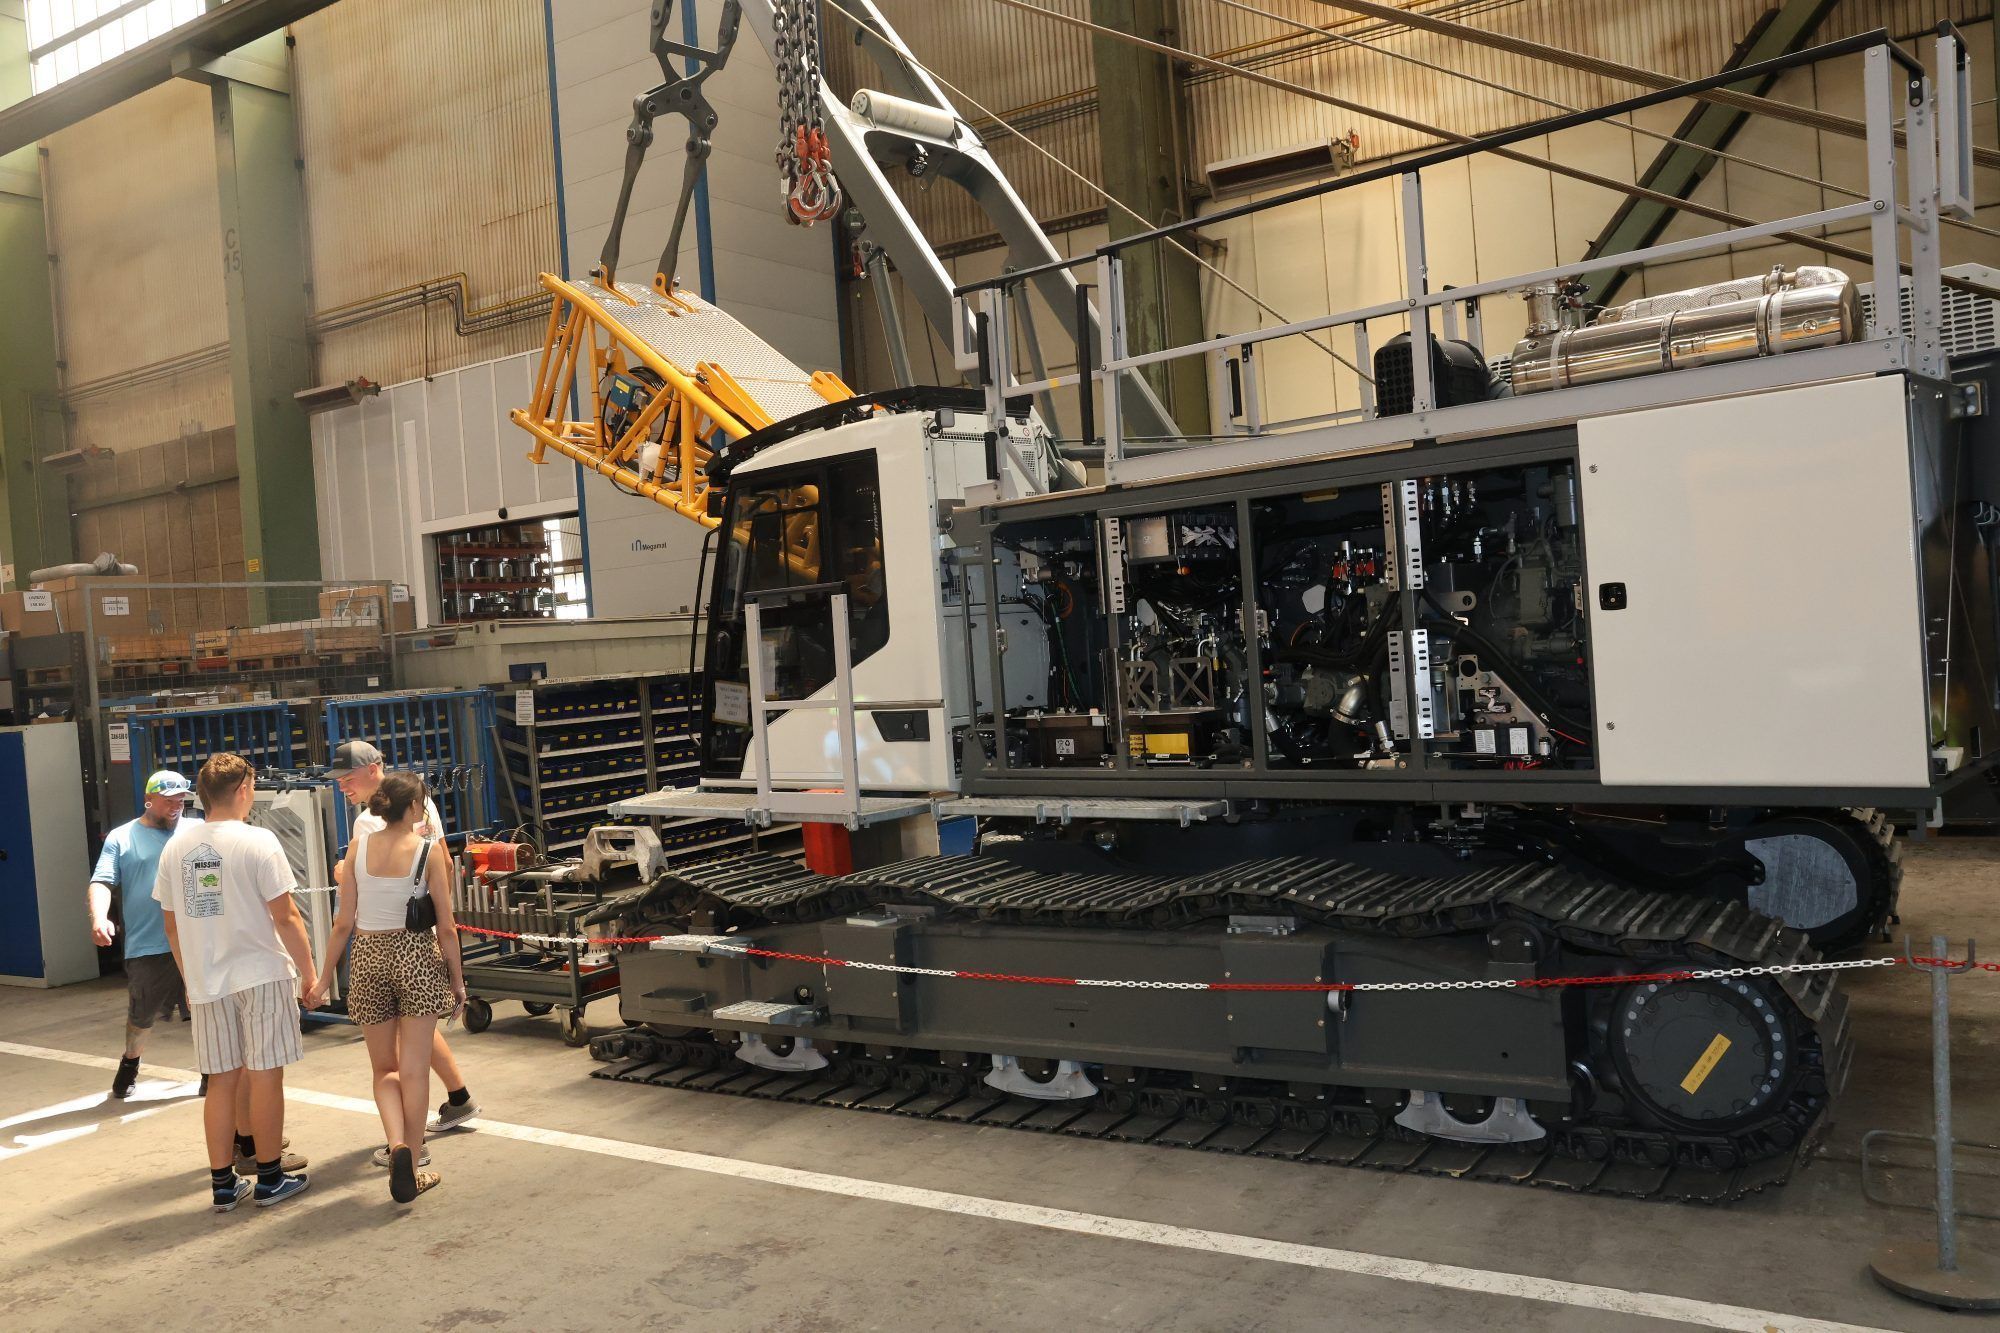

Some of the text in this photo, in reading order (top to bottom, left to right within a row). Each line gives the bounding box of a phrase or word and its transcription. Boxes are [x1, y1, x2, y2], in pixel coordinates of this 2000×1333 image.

[225, 228, 236, 249] C
[223, 251, 241, 273] 15
[194, 860, 220, 869] MISSING
